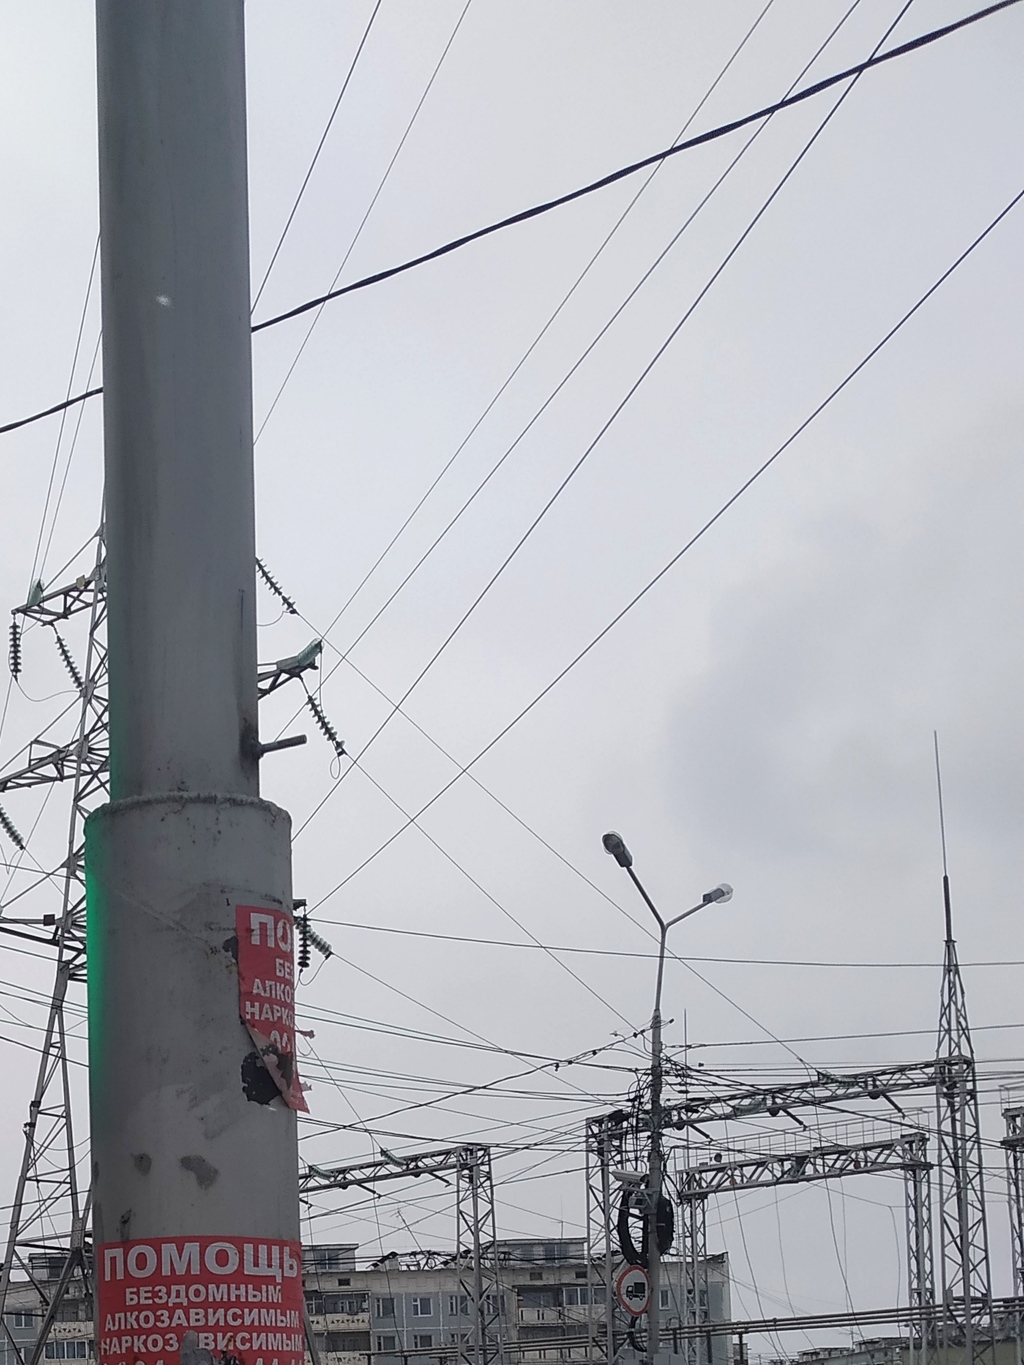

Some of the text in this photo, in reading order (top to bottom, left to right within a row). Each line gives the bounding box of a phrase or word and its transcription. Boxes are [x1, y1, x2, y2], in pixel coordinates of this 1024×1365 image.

[252, 978, 294, 1005] АЛКО
[104, 1241, 299, 1283] ПОМОЩЬ
[125, 1283, 282, 1307] БЕЗДОМНЫМ
[104, 1307, 300, 1332] АЛКОЗАВИСИМЫМ
[101, 1332, 303, 1355] НАРКОЗВИСИМЫМ
